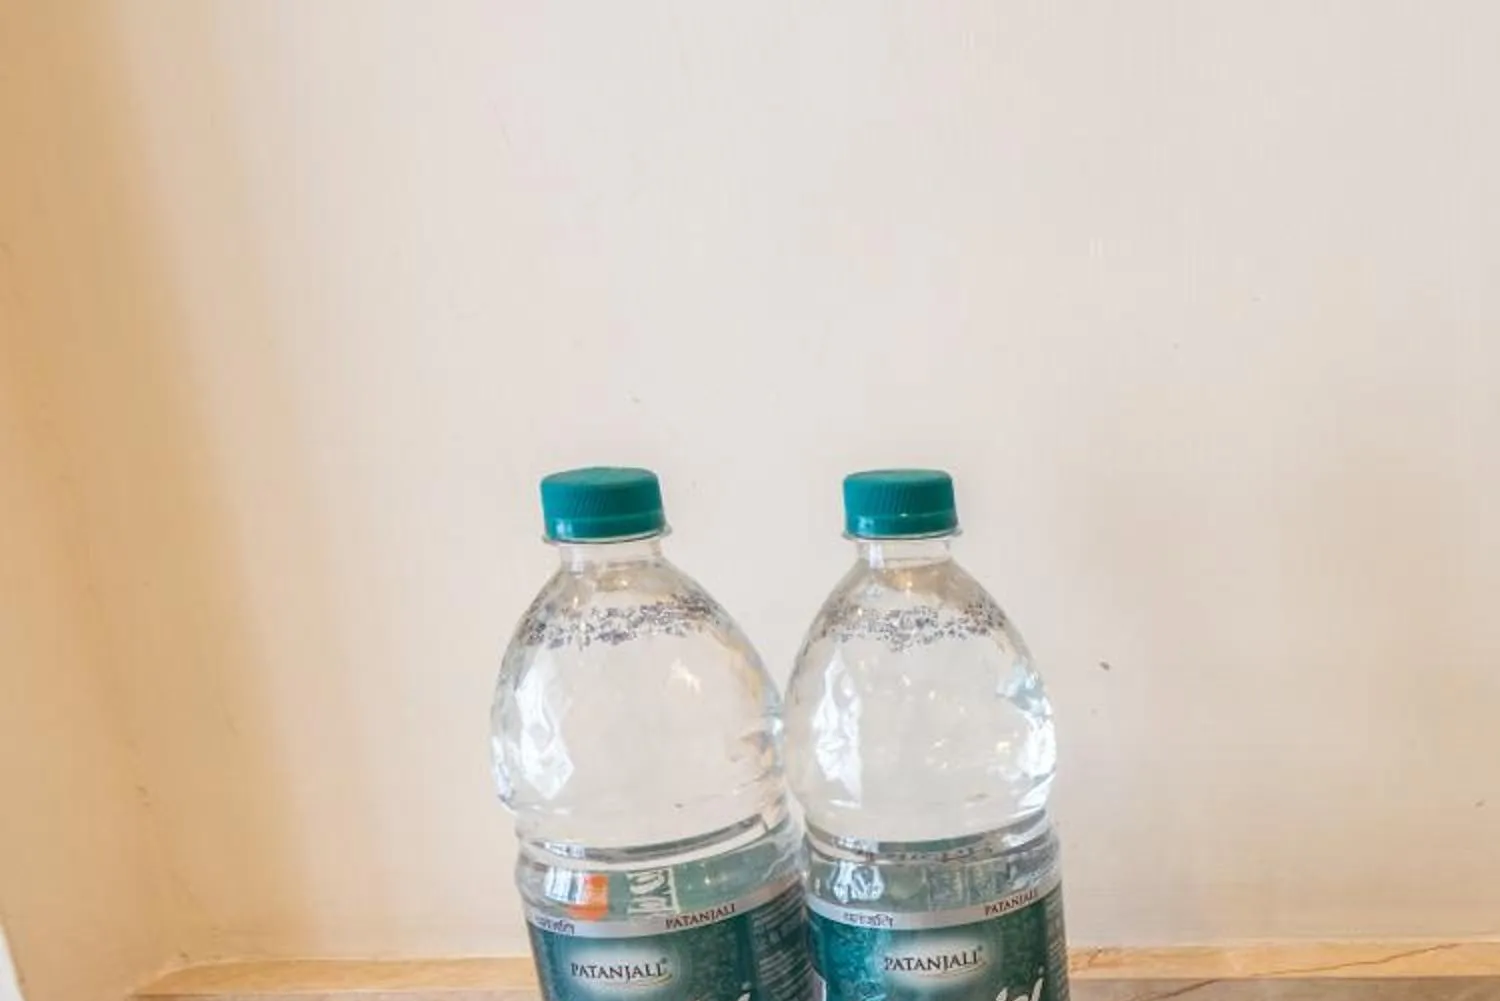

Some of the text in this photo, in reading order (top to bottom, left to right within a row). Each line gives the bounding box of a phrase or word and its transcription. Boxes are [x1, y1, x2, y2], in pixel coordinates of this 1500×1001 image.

[985, 888, 1038, 915] PATANJALI
[665, 903, 737, 929] PATANJALI
[570, 961, 665, 983] PATANJALI
[884, 951, 980, 971] PATANJALI
